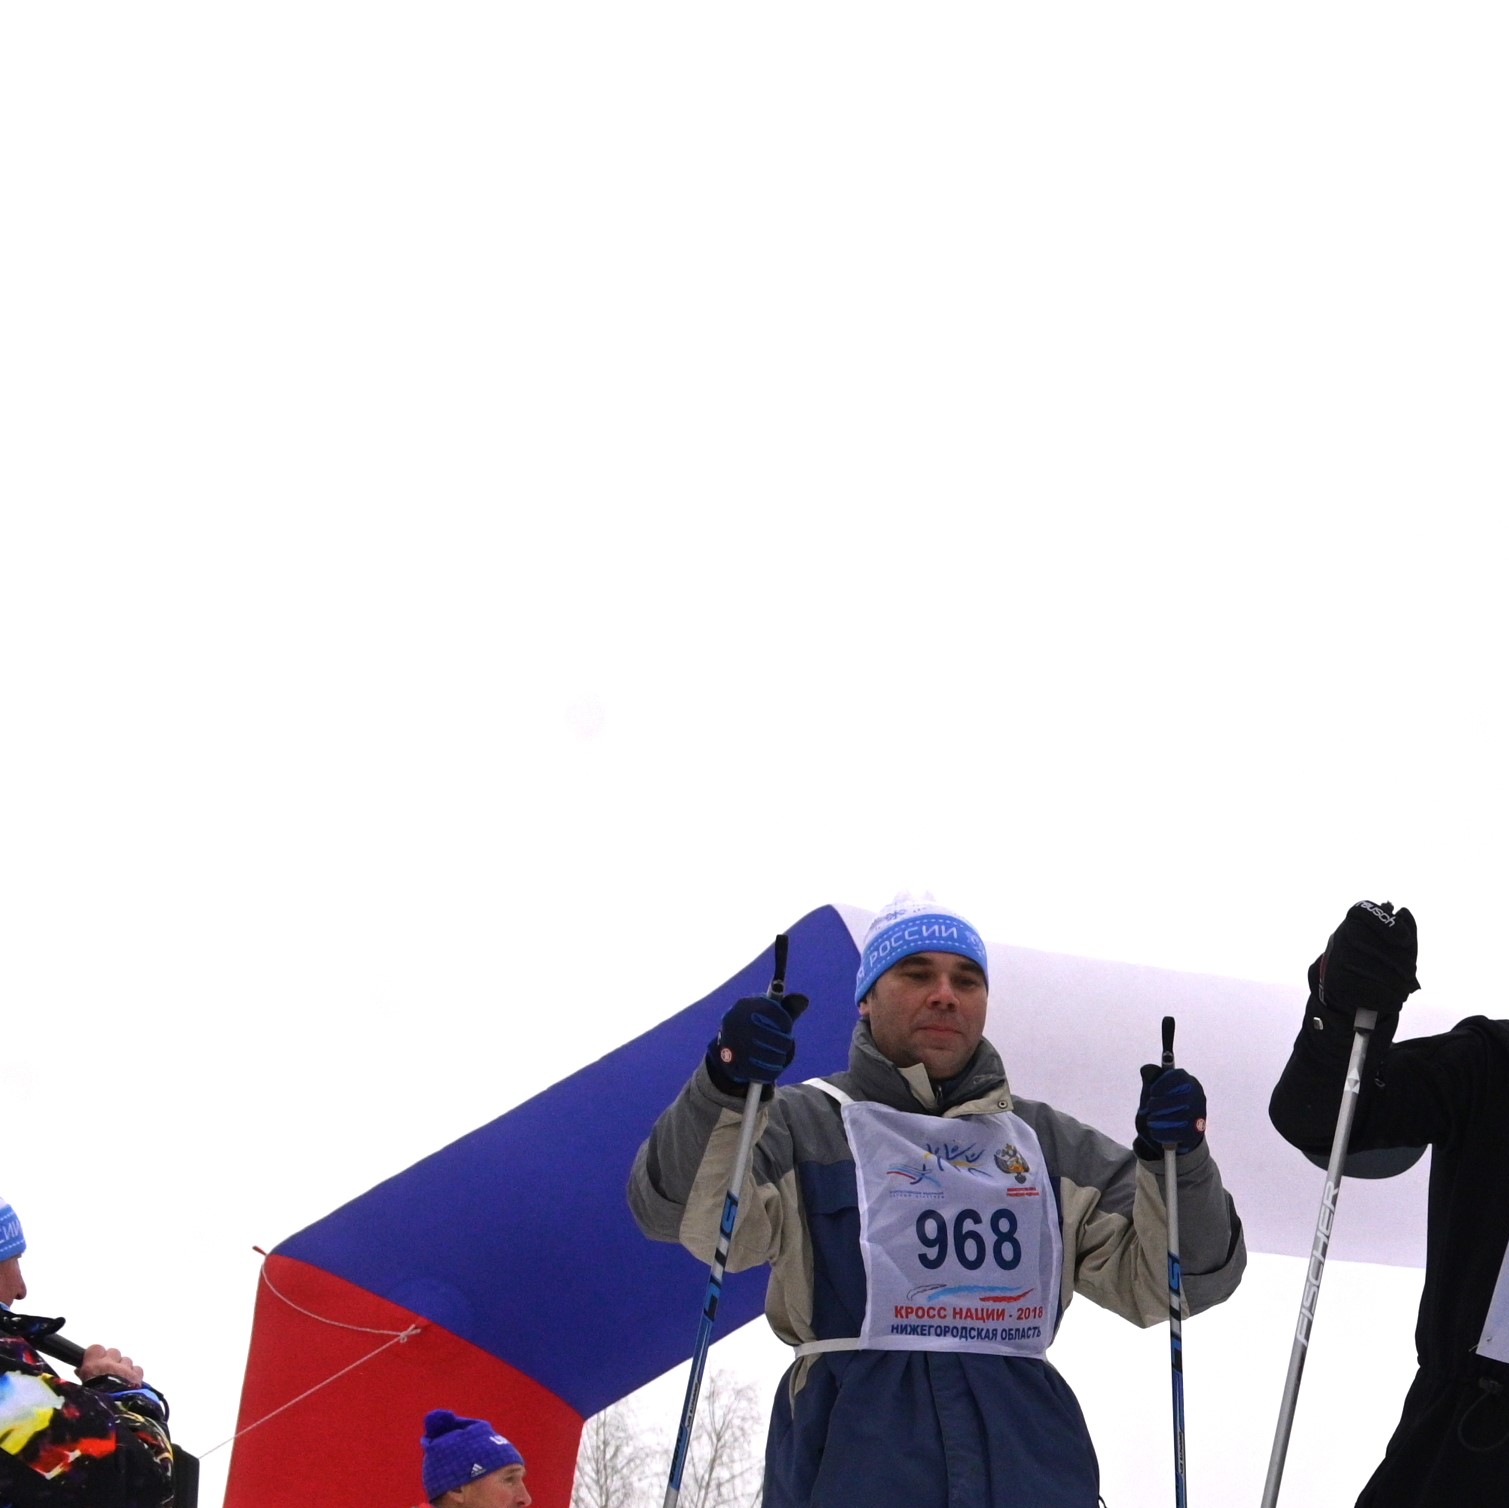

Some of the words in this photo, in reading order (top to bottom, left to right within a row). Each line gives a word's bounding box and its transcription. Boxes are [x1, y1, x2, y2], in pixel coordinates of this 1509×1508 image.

[869, 925, 958, 968] РОССИИ
[916, 1208, 1022, 1271] 968
[894, 1305, 948, 1319] КРОСС
[952, 1306, 1006, 1323] НАЦИИ
[1016, 1305, 1044, 1321] 2018
[890, 1323, 998, 1342] НИЖЕГОРОДСКАЯ
[1000, 1325, 1042, 1341] ОБЛАСТЬ
